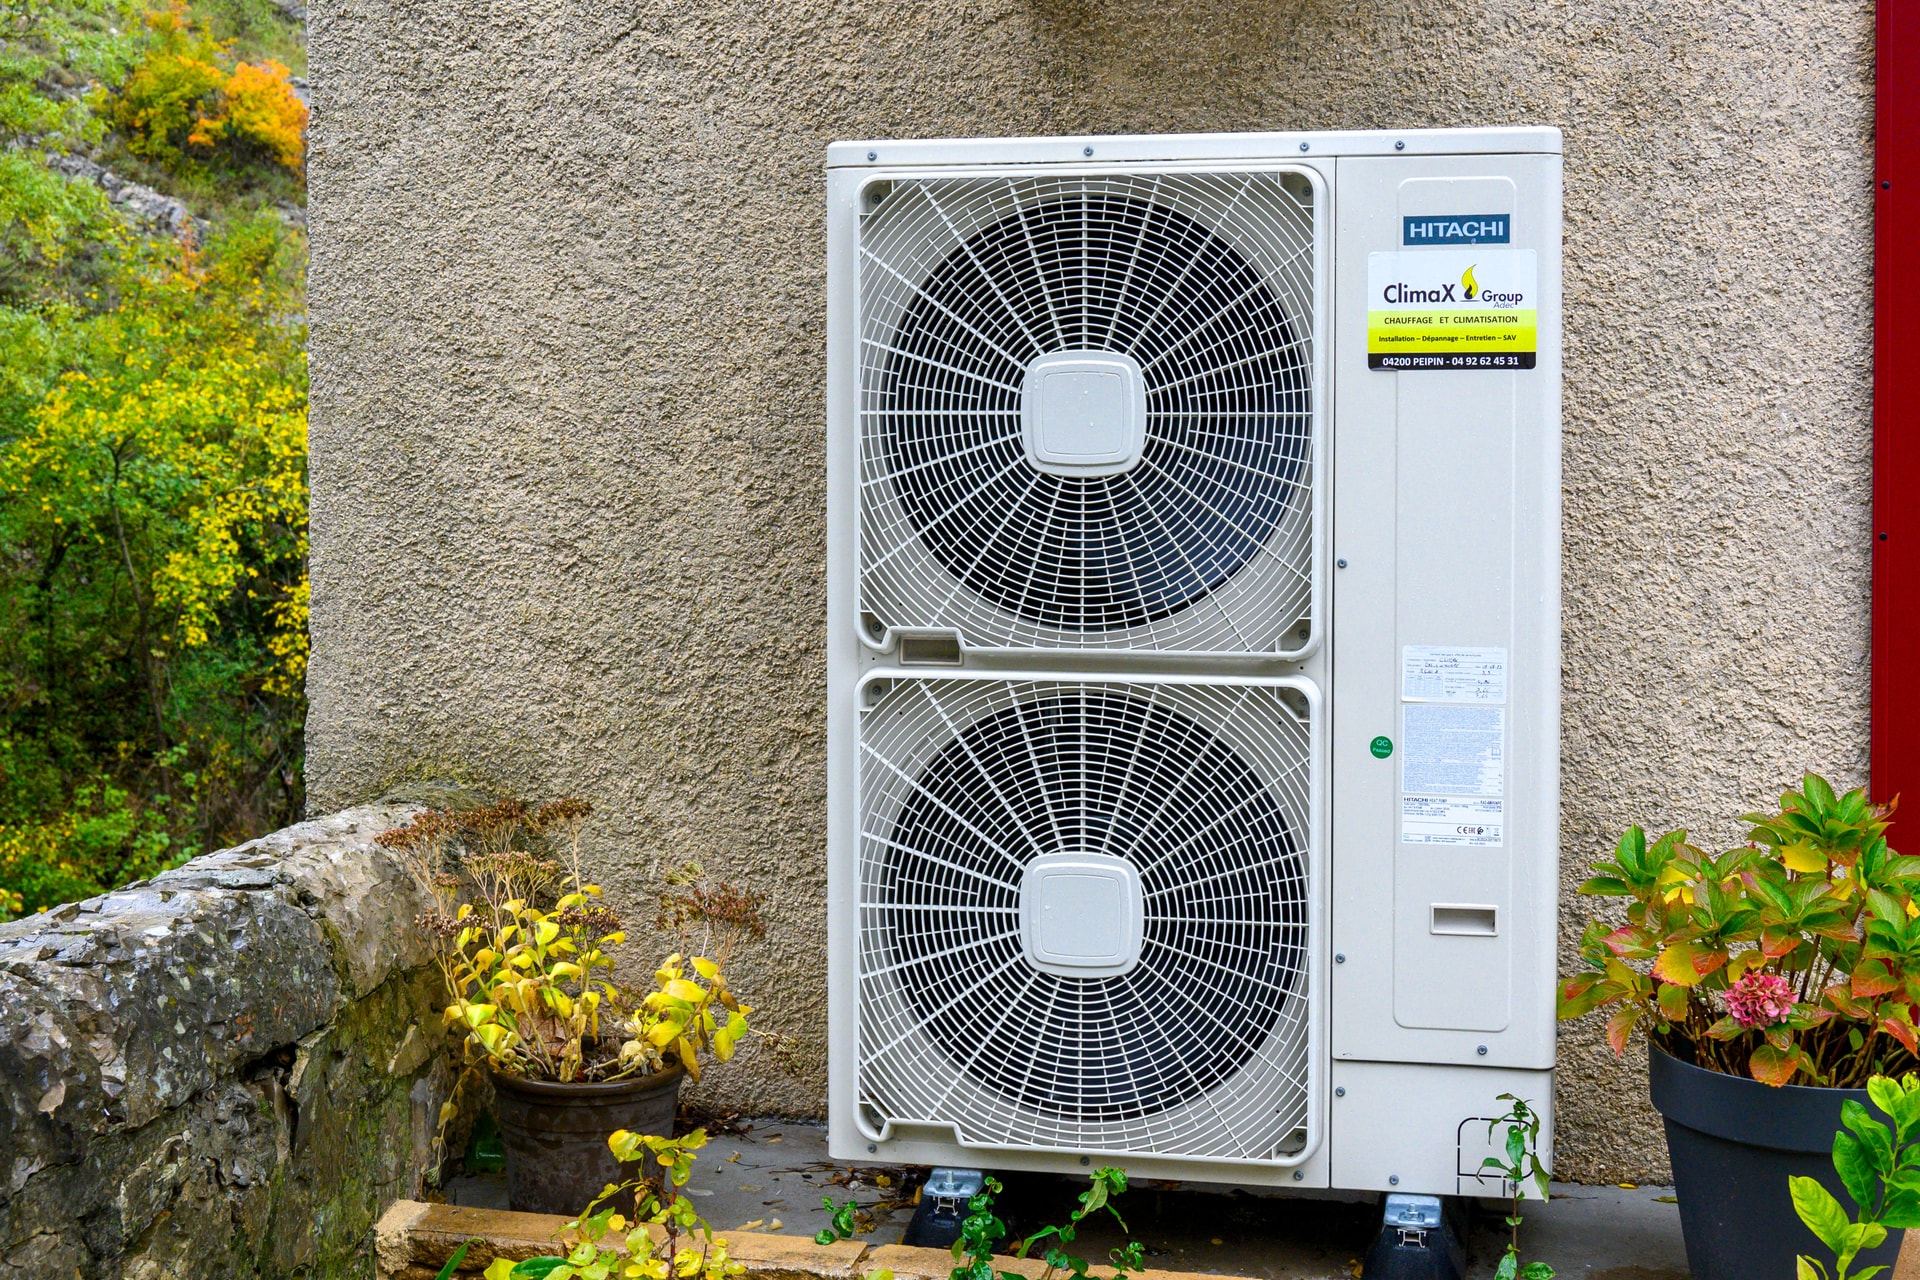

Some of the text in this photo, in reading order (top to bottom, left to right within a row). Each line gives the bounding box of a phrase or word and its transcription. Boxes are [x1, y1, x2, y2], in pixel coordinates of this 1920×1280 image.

[1410, 221, 1503, 238] HITACHI
[1383, 282, 1523, 305] ClimaX Group
[1493, 301, 1515, 309] Adec
[1384, 315, 1518, 325] CHAUFFAGE ET CLIMATISATION
[1422, 334, 1459, 343] Dépannage
[1466, 334, 1496, 342] Entretien
[1382, 357, 1411, 366] 04200
[1413, 357, 1444, 366] PEIPIN
[1451, 357, 1464, 366] 04
[1466, 357, 1478, 366] 92
[1479, 357, 1492, 365] 62
[1493, 357, 1505, 365] 45
[1506, 356, 1519, 365] 31
[1376, 739, 1389, 747] QC
